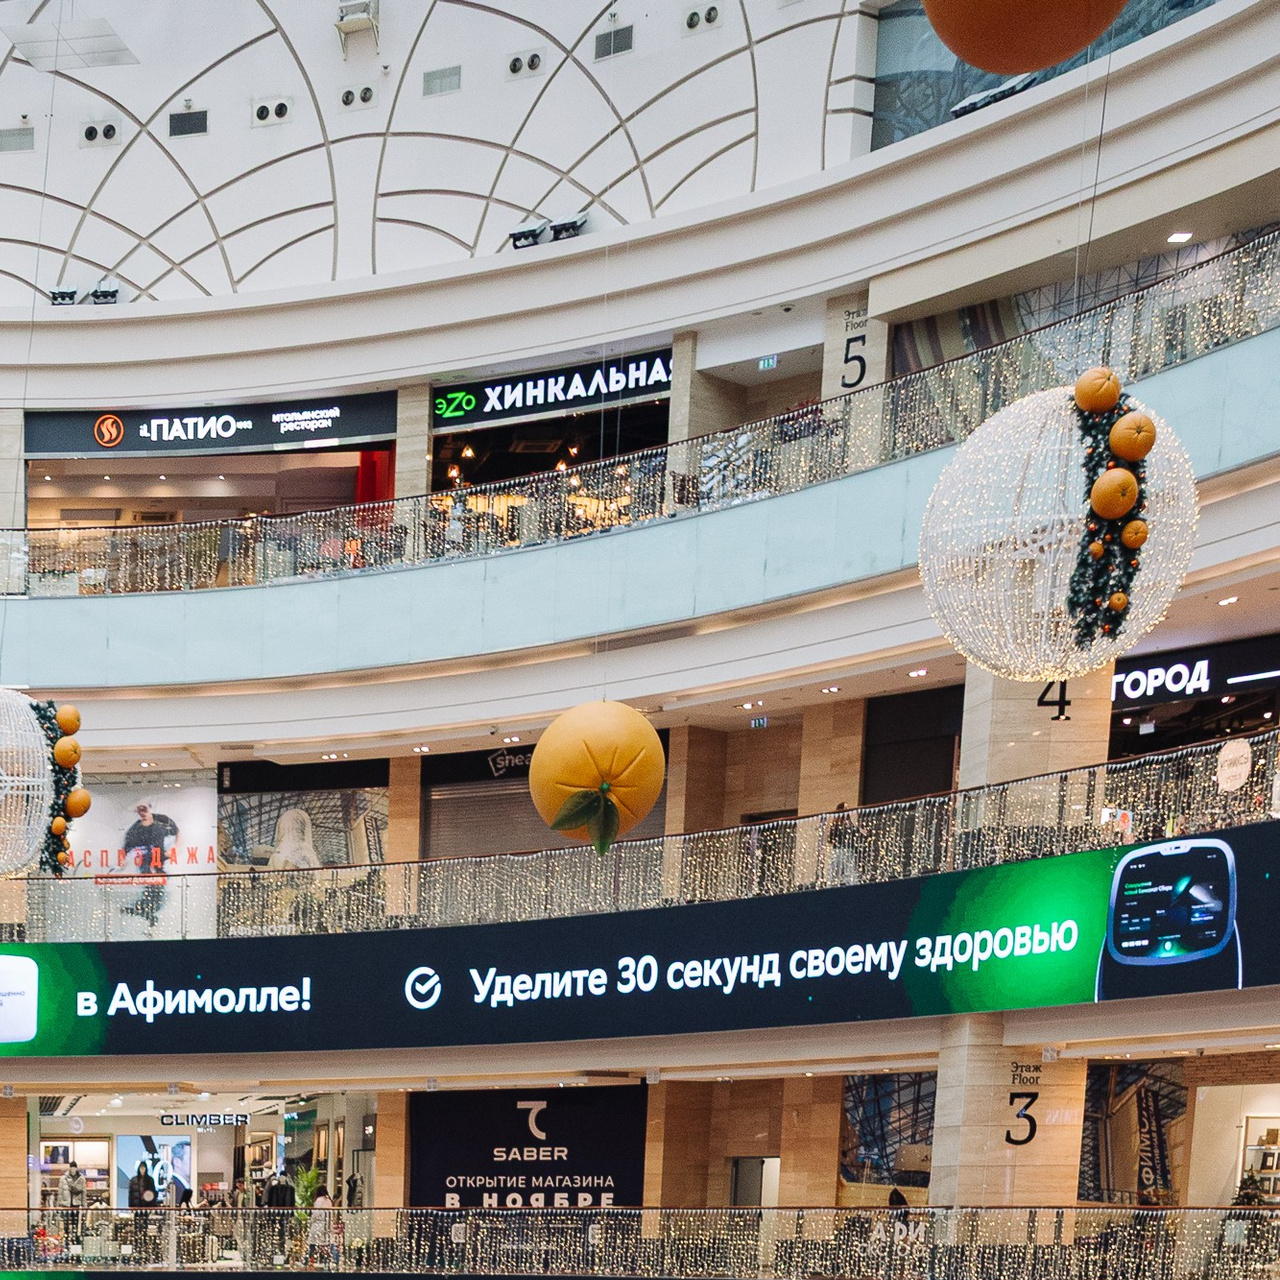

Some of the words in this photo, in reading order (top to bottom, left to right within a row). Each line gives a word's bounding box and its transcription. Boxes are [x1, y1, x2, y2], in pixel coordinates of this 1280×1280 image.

[845, 319, 868, 331] Floor
[841, 334, 867, 388] 5
[483, 357, 672, 413] ХИНКАЛЬНА
[150, 414, 237, 441] ПАТИО
[1111, 659, 1210, 701] ГОРОД
[1036, 678, 1072, 721] 4
[365, 815, 379, 863] ФИМОЛЛ
[66, 845, 216, 869] АСПРОДАЖА
[469, 966, 608, 1008] Уделите
[616, 954, 660, 993] 30
[666, 951, 782, 996] секунд
[788, 937, 909, 981] своему
[913, 918, 1080, 970] здоровью
[76, 991, 99, 1017] в
[106, 976, 312, 1024] Афимолле!
[1010, 1061, 1042, 1073] Этаж
[1011, 1073, 1041, 1085] Floor
[160, 1113, 251, 1127] CLIMBER
[1004, 1091, 1040, 1146] 3
[493, 1147, 569, 1161] SABER
[1138, 1087, 1159, 1204] АФИМО
[445, 1175, 526, 1188] ОТКРЫТИЕ
[531, 1175, 615, 1188] МАГАЗИНА
[445, 1192, 461, 1208] В
[482, 1192, 615, 1208] НОЯБРЕ
